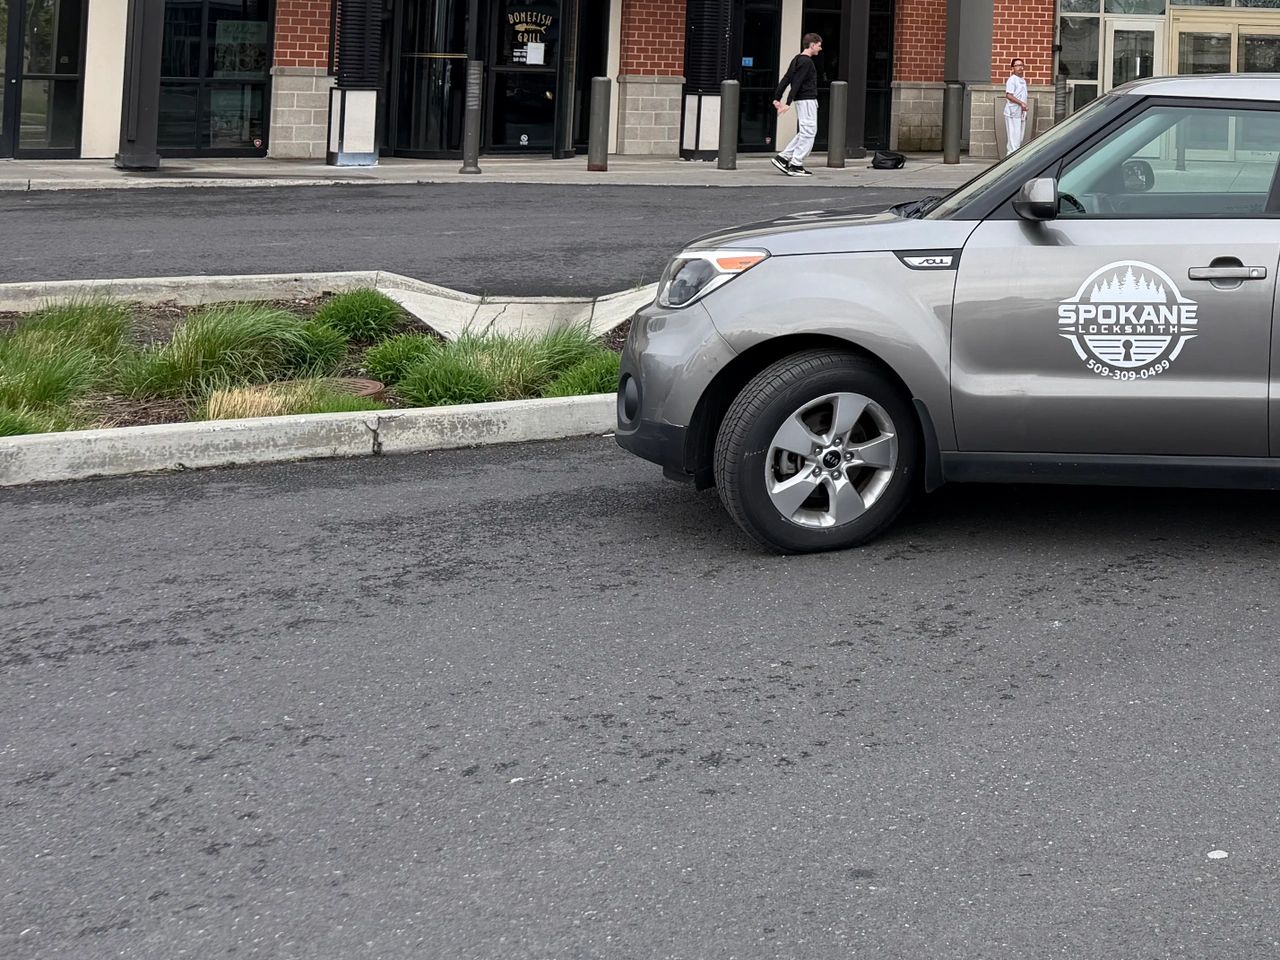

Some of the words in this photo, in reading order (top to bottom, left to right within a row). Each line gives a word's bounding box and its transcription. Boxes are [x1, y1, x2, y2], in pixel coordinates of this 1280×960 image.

[508, 11, 553, 26] BONEFISH
[517, 32, 541, 43] GRILL
[1057, 304, 1199, 325] SPOKANE
[1078, 324, 1178, 334] LOCKSMITH
[1086, 359, 1170, 381] 509-309-0499
[824, 453, 838, 466] KIA
